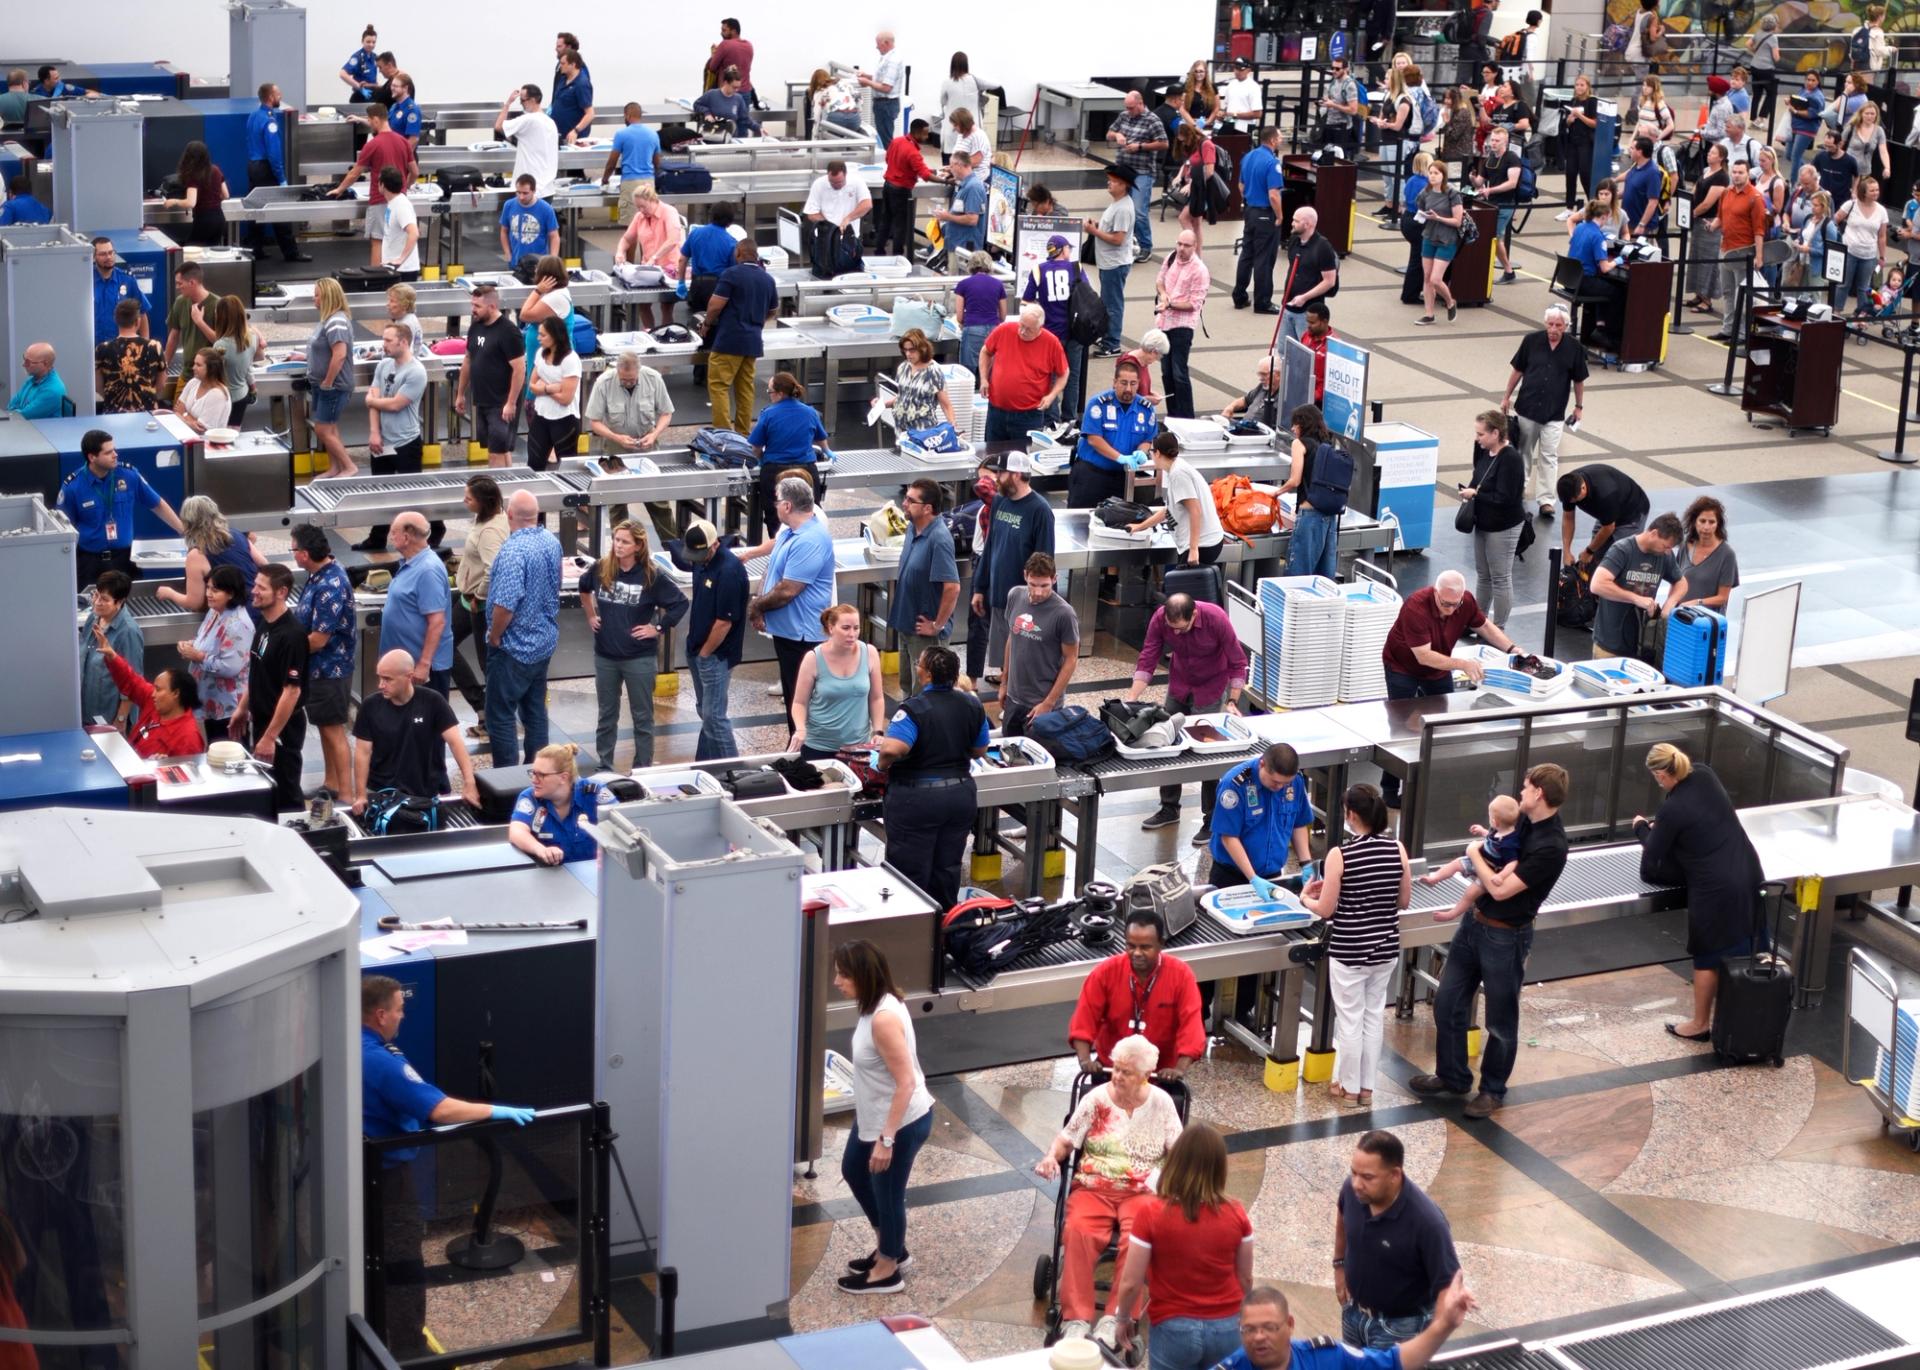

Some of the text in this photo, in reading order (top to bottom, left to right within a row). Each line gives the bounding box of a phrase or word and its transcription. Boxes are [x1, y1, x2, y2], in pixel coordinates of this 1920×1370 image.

[1023, 222, 1036, 231] Hey
[1045, 269, 1070, 302] 18
[1328, 367, 1360, 389] HOLD IT
